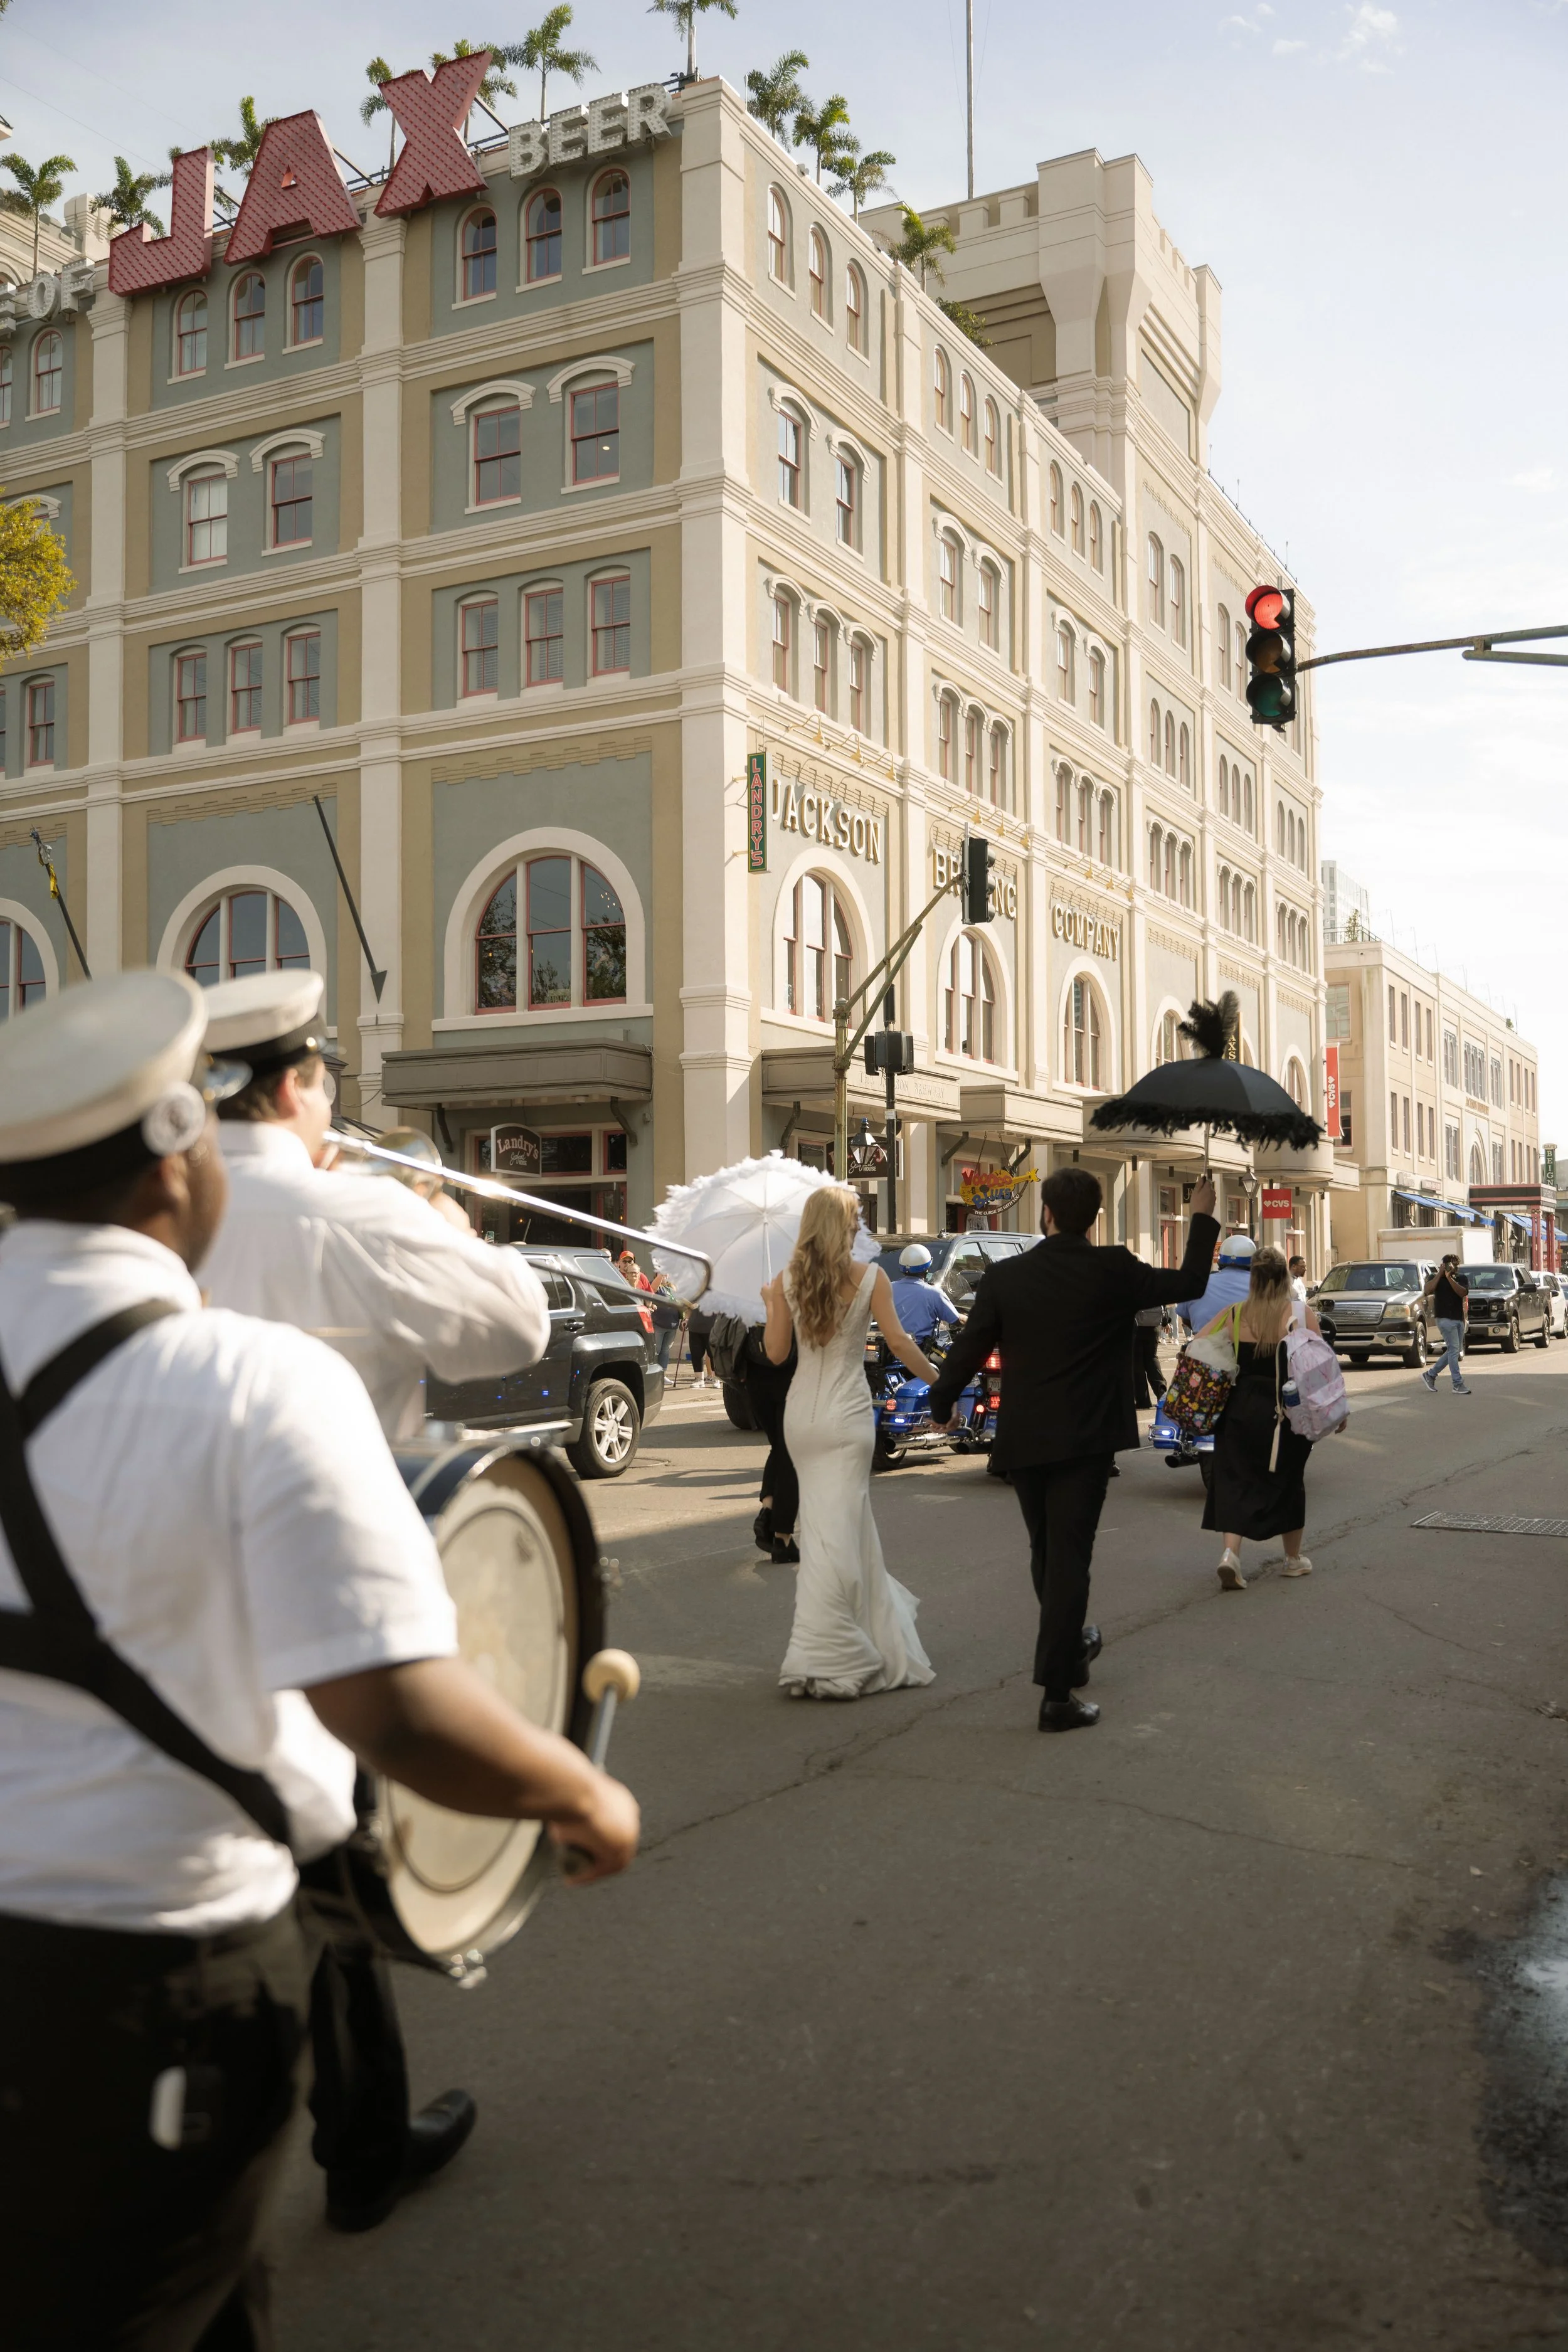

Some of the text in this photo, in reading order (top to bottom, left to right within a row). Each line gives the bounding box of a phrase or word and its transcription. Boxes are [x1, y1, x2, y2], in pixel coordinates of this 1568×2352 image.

[110, 50, 492, 297] JAX
[508, 83, 673, 182] BEER
[750, 758, 763, 866] LANDRY'S
[772, 779, 1120, 961] JACKSON BRNG COMPANY
[1328, 1083, 1336, 1100] CVS
[497, 1135, 539, 1159] Landry's
[961, 1167, 1013, 1187] VOODOO
[972, 1187, 1012, 1209] BLUES
[1012, 1194, 1020, 1202] YOU
